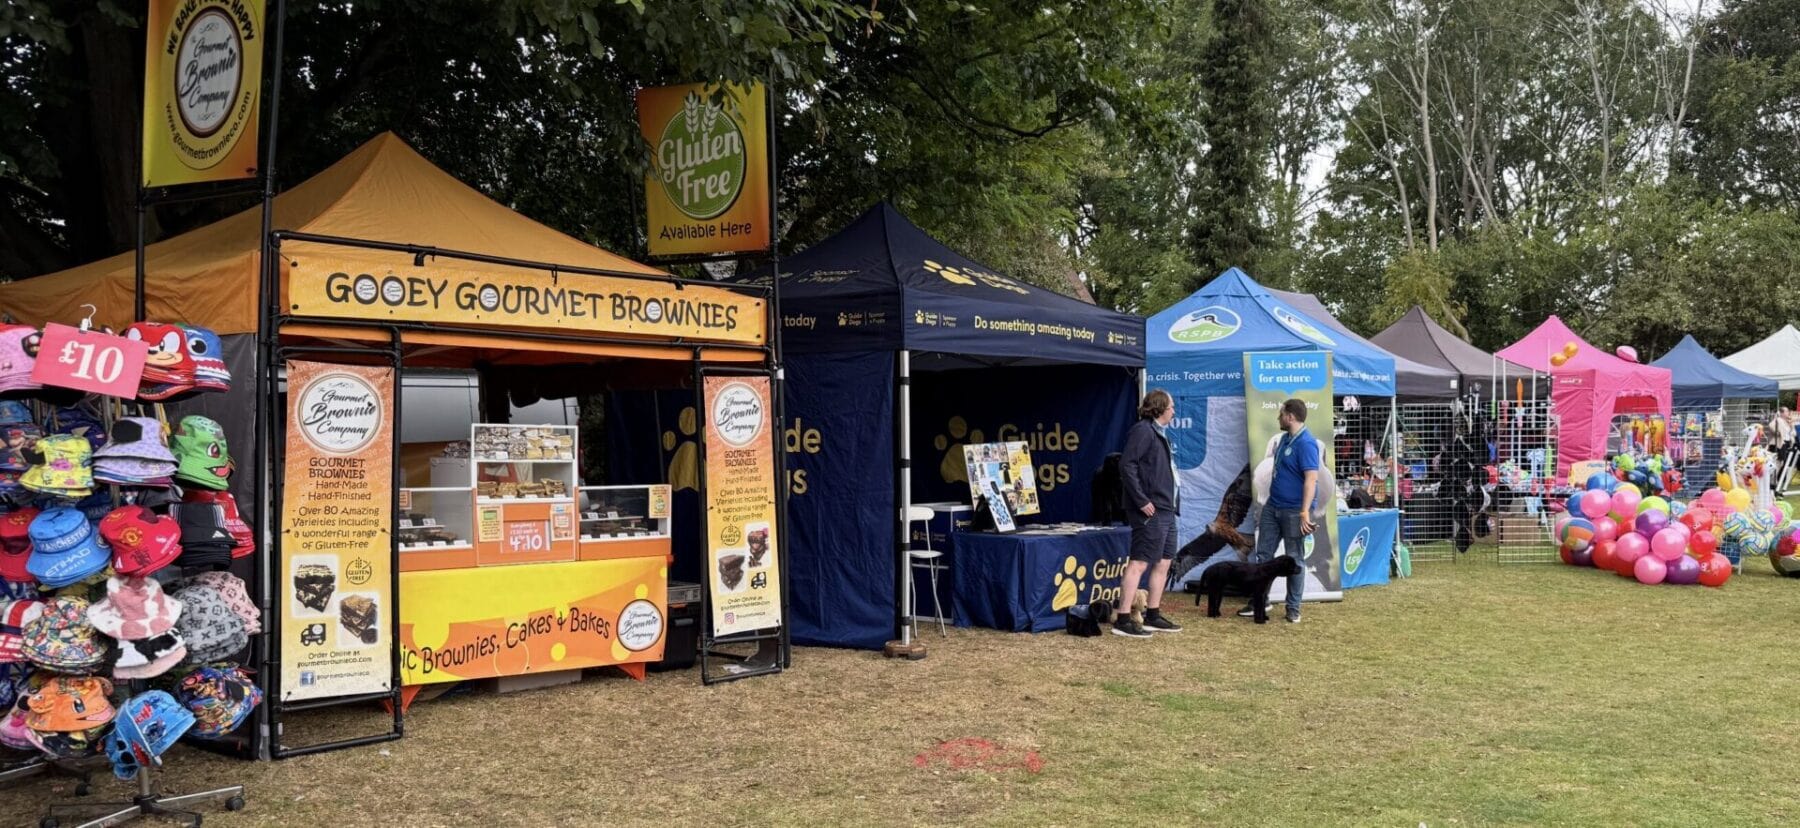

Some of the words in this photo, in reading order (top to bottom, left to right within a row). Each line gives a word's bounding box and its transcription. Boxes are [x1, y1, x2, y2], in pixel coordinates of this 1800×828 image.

[166, 28, 180, 55] WE
[231, 0, 254, 40] HAPPY
[193, 34, 232, 58] Gourmet
[179, 47, 237, 98] Brownie
[188, 86, 230, 112] Company
[165, 91, 251, 159] www.gourmetbrownieco.com
[657, 130, 742, 183] Gluten
[676, 169, 731, 207] Free
[659, 223, 716, 240] Available
[720, 222, 752, 238] Here
[325, 272, 448, 310] GOOEY
[455, 281, 604, 320] GOURMET
[609, 292, 738, 331] BROWNIES
[784, 313, 817, 330] today
[974, 315, 988, 329] Do
[989, 318, 1035, 335] something
[1037, 323, 1071, 340] amazing
[1073, 326, 1095, 343] today
[1177, 329, 1225, 338] RSPB
[57, 340, 124, 384] £10
[1258, 359, 1285, 369] Take
[1286, 358, 1319, 369] action
[1155, 371, 1181, 381] crisis.
[1183, 371, 1224, 383] Together
[1227, 371, 1241, 379] we
[1258, 373, 1274, 384] for
[1276, 373, 1311, 383] nature
[321, 389, 369, 404] Gourmet
[725, 397, 754, 408] Gourmet
[1261, 400, 1277, 409] Join
[303, 401, 377, 426] Brownie
[717, 406, 760, 426] Brownie
[316, 419, 369, 440] Company
[725, 422, 756, 433] Company
[724, 449, 757, 459] GOURMET
[309, 456, 366, 468] GOURMET
[725, 458, 757, 467] BROWNIES
[309, 467, 366, 479] BROWNIES
[315, 480, 368, 490] Hand-Made
[308, 490, 372, 501] Hand-Finished
[298, 506, 321, 516] Over
[323, 505, 338, 515] 80
[340, 505, 380, 517] Amazing
[338, 516, 380, 527] including
[302, 528, 350, 538] wonderful
[352, 529, 377, 538] range
[302, 540, 313, 550] of
[315, 540, 369, 550] Gluten-Free
[45, 548, 91, 577] ETIHAD
[619, 615, 658, 635] Brownie
[421, 633, 501, 675] Brownies,
[505, 611, 554, 649] Cakes
[569, 607, 611, 640] Bakes
[308, 651, 328, 660] Order
[330, 650, 352, 658] Online
